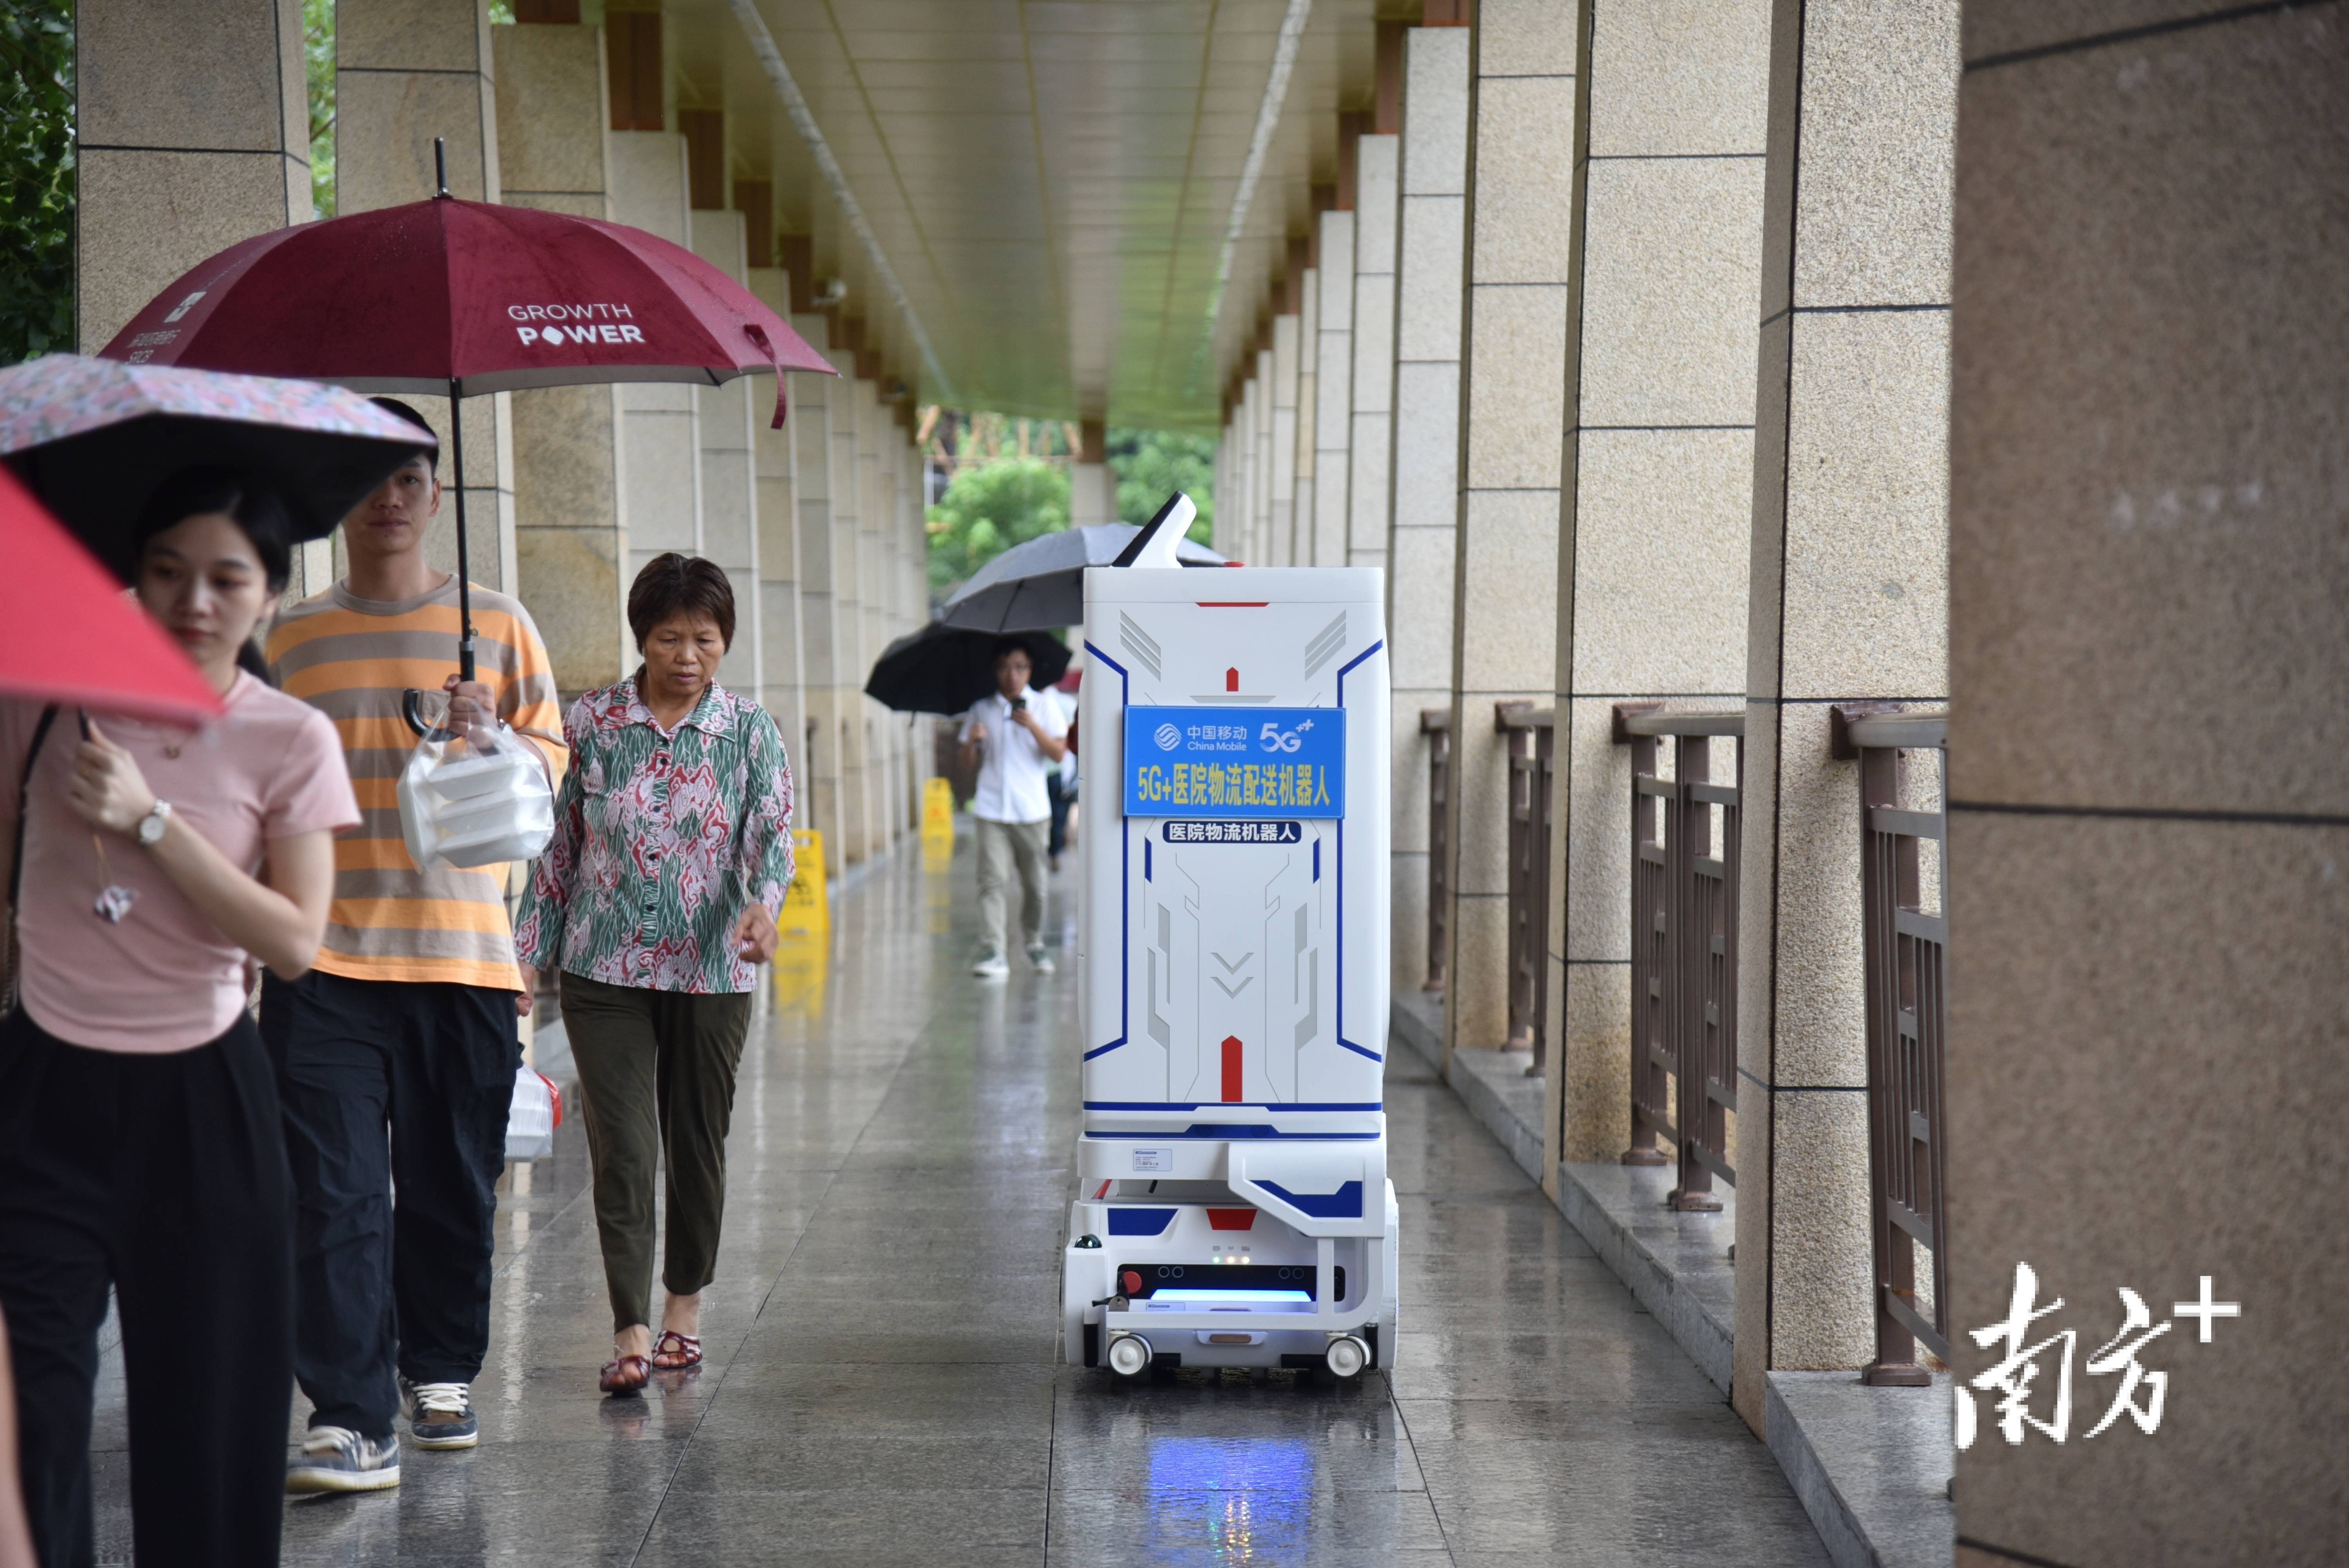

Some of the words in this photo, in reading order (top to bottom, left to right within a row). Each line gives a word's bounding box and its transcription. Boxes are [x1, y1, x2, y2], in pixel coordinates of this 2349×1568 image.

[508, 303, 633, 320] GROWTH
[1187, 725, 1247, 740] 中国移动
[1187, 741, 1214, 751] China
[1216, 742, 1247, 751] Mobile
[1138, 762, 1331, 806] 5G+医院物流配送机器人
[1169, 823, 1296, 842] 医院物流机器人
